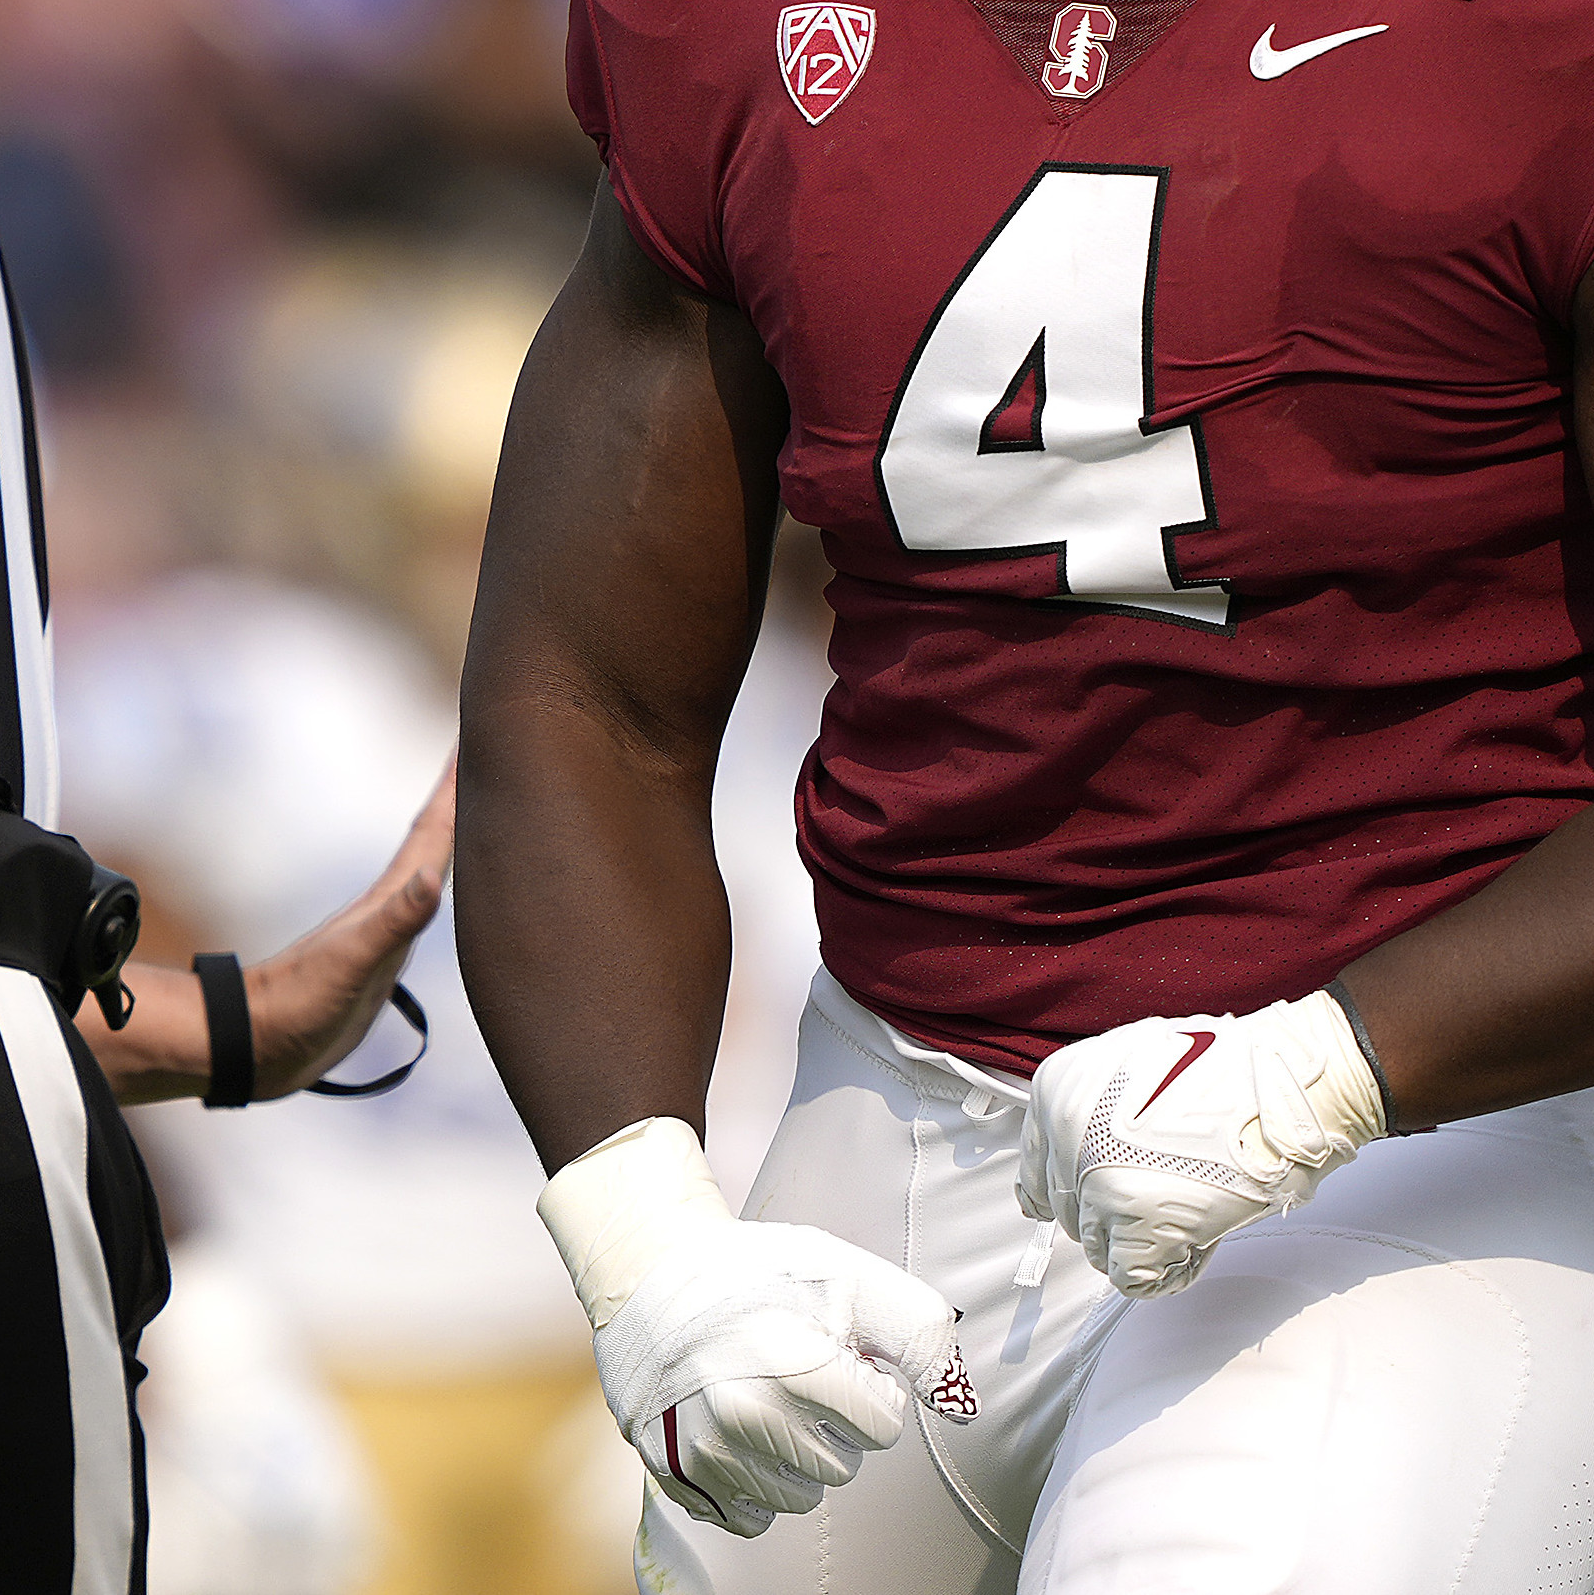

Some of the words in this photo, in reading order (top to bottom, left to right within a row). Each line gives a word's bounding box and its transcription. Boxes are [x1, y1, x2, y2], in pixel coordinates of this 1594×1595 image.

[784, 7, 870, 74] PAC
[798, 53, 844, 96] 12
[1041, 2, 1118, 99] S
[872, 162, 1237, 638] 4
